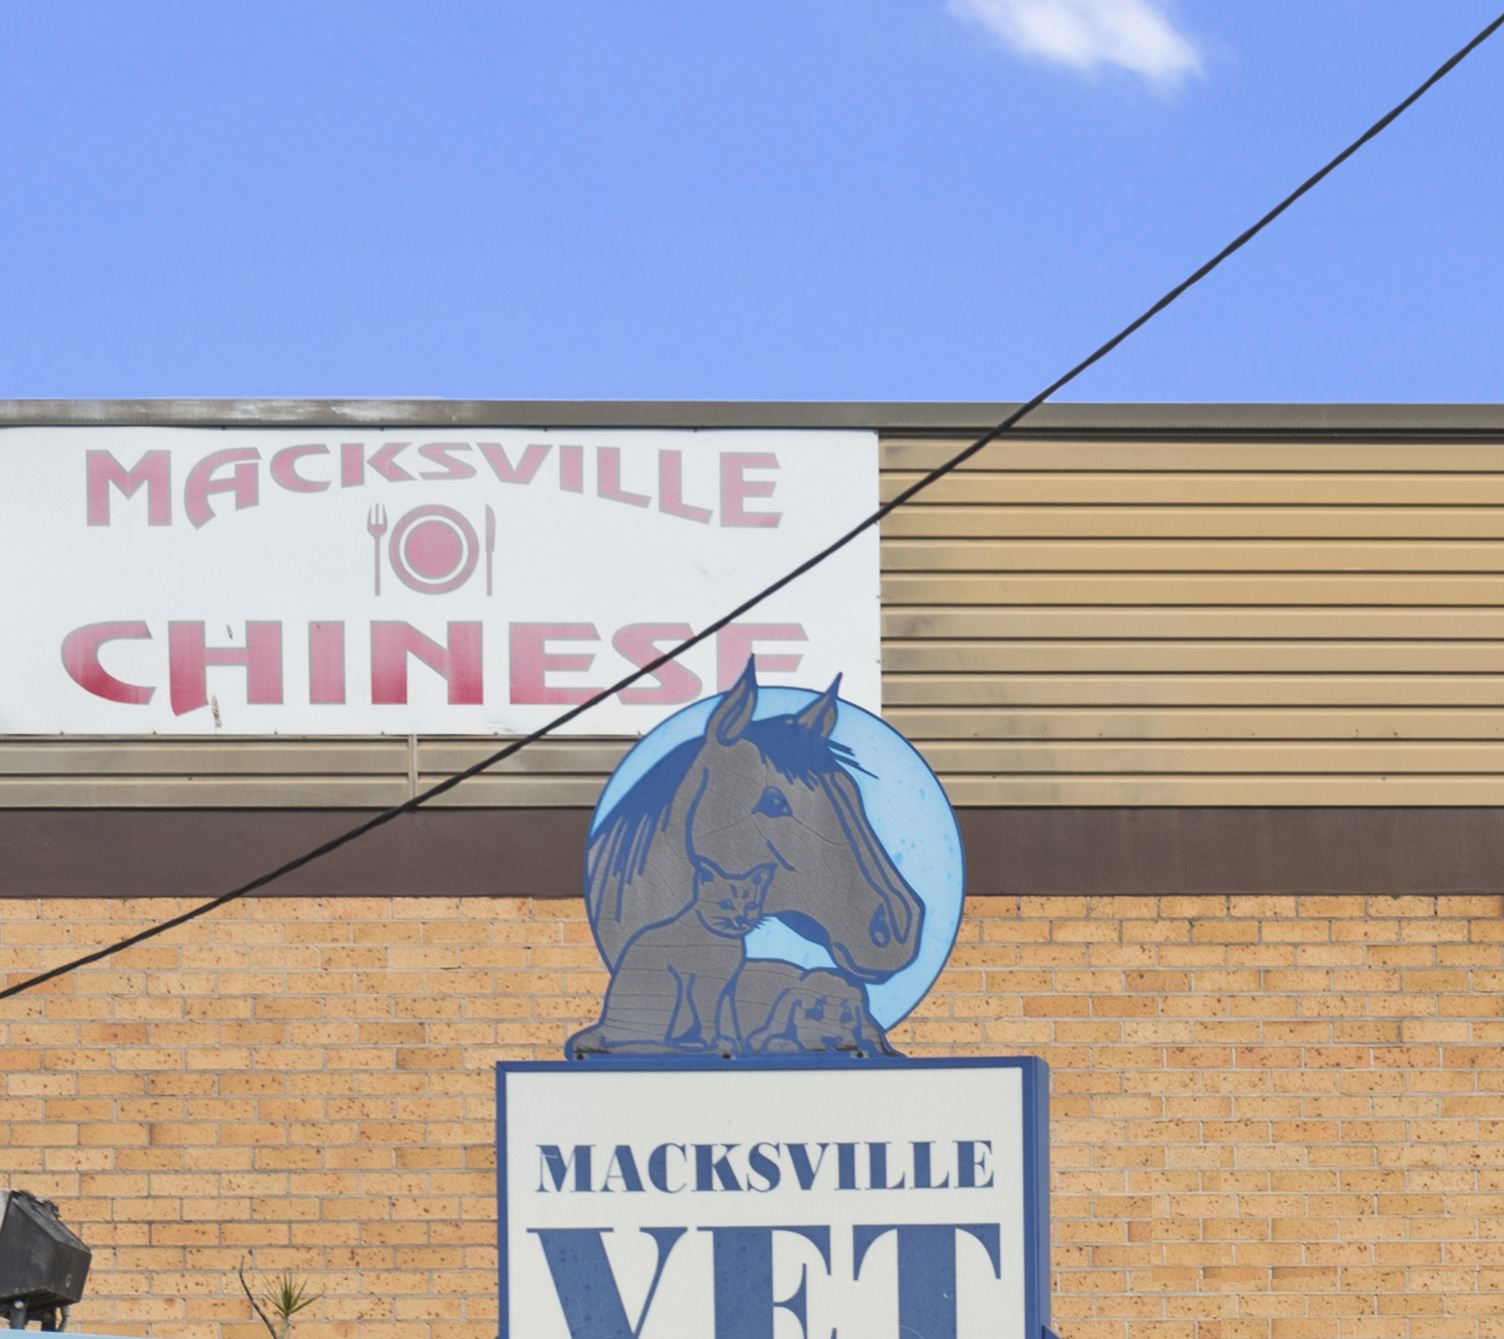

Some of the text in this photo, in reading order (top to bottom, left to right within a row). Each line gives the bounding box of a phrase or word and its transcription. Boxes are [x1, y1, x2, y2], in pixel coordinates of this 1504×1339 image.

[86, 442, 782, 530] MACKSVILLE
[61, 619, 809, 716] CHINESE
[535, 1140, 995, 1194] MACKSVILLE
